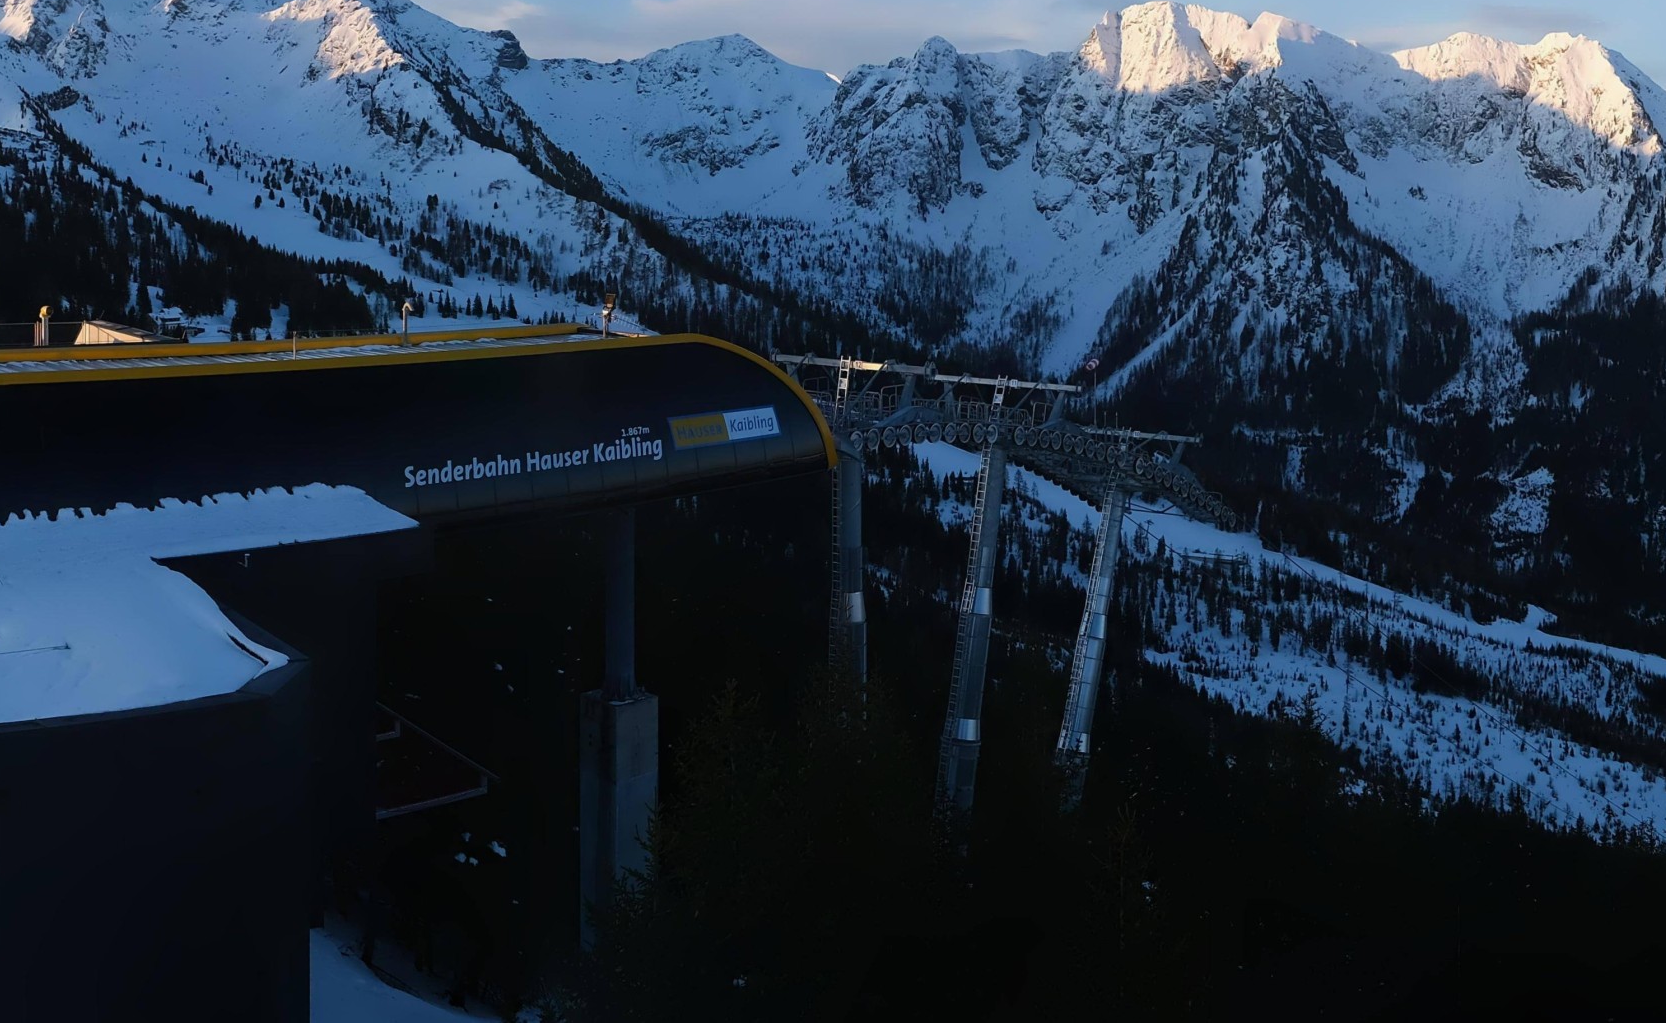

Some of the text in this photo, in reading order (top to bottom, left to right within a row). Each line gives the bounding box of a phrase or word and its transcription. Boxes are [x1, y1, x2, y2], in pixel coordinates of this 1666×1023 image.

[677, 415, 774, 440] HAUSER Kaibling
[404, 436, 663, 488] Senderbahn Hauser Kaibling
